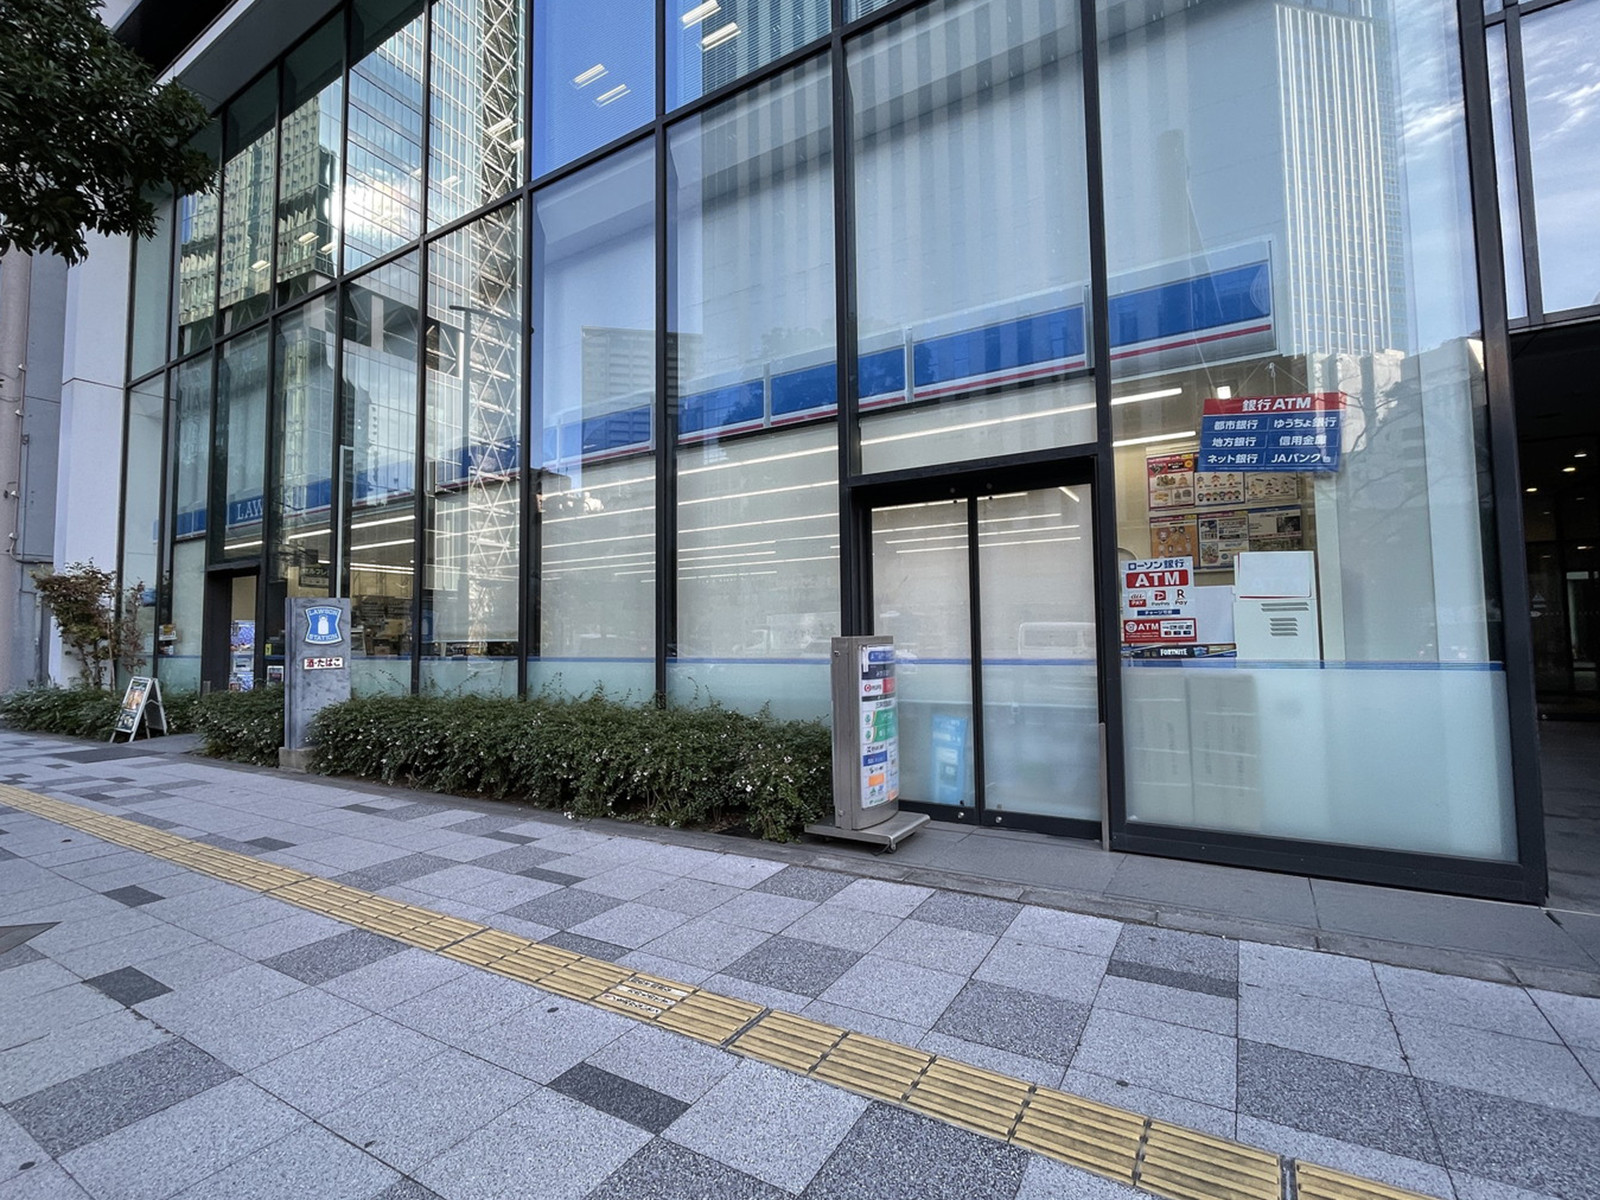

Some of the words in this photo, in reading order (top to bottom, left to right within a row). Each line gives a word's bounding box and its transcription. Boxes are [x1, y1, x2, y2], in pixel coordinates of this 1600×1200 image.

[1242, 397, 1311, 412] 銀行ATM
[1214, 419, 1258, 430] 都市銀行
[1274, 417, 1337, 428] ゆうちょ銀行
[1212, 436, 1256, 447] 地方銀行
[1279, 435, 1327, 446] 信用金庫
[1207, 453, 1258, 464] ネット銀行
[236, 498, 263, 520] LAW
[1128, 559, 1184, 571] ローソン銀行
[1135, 571, 1180, 587] ATM
[308, 608, 339, 616] LAWSON
[1138, 622, 1159, 631] ATM
[309, 633, 339, 641] STATION
